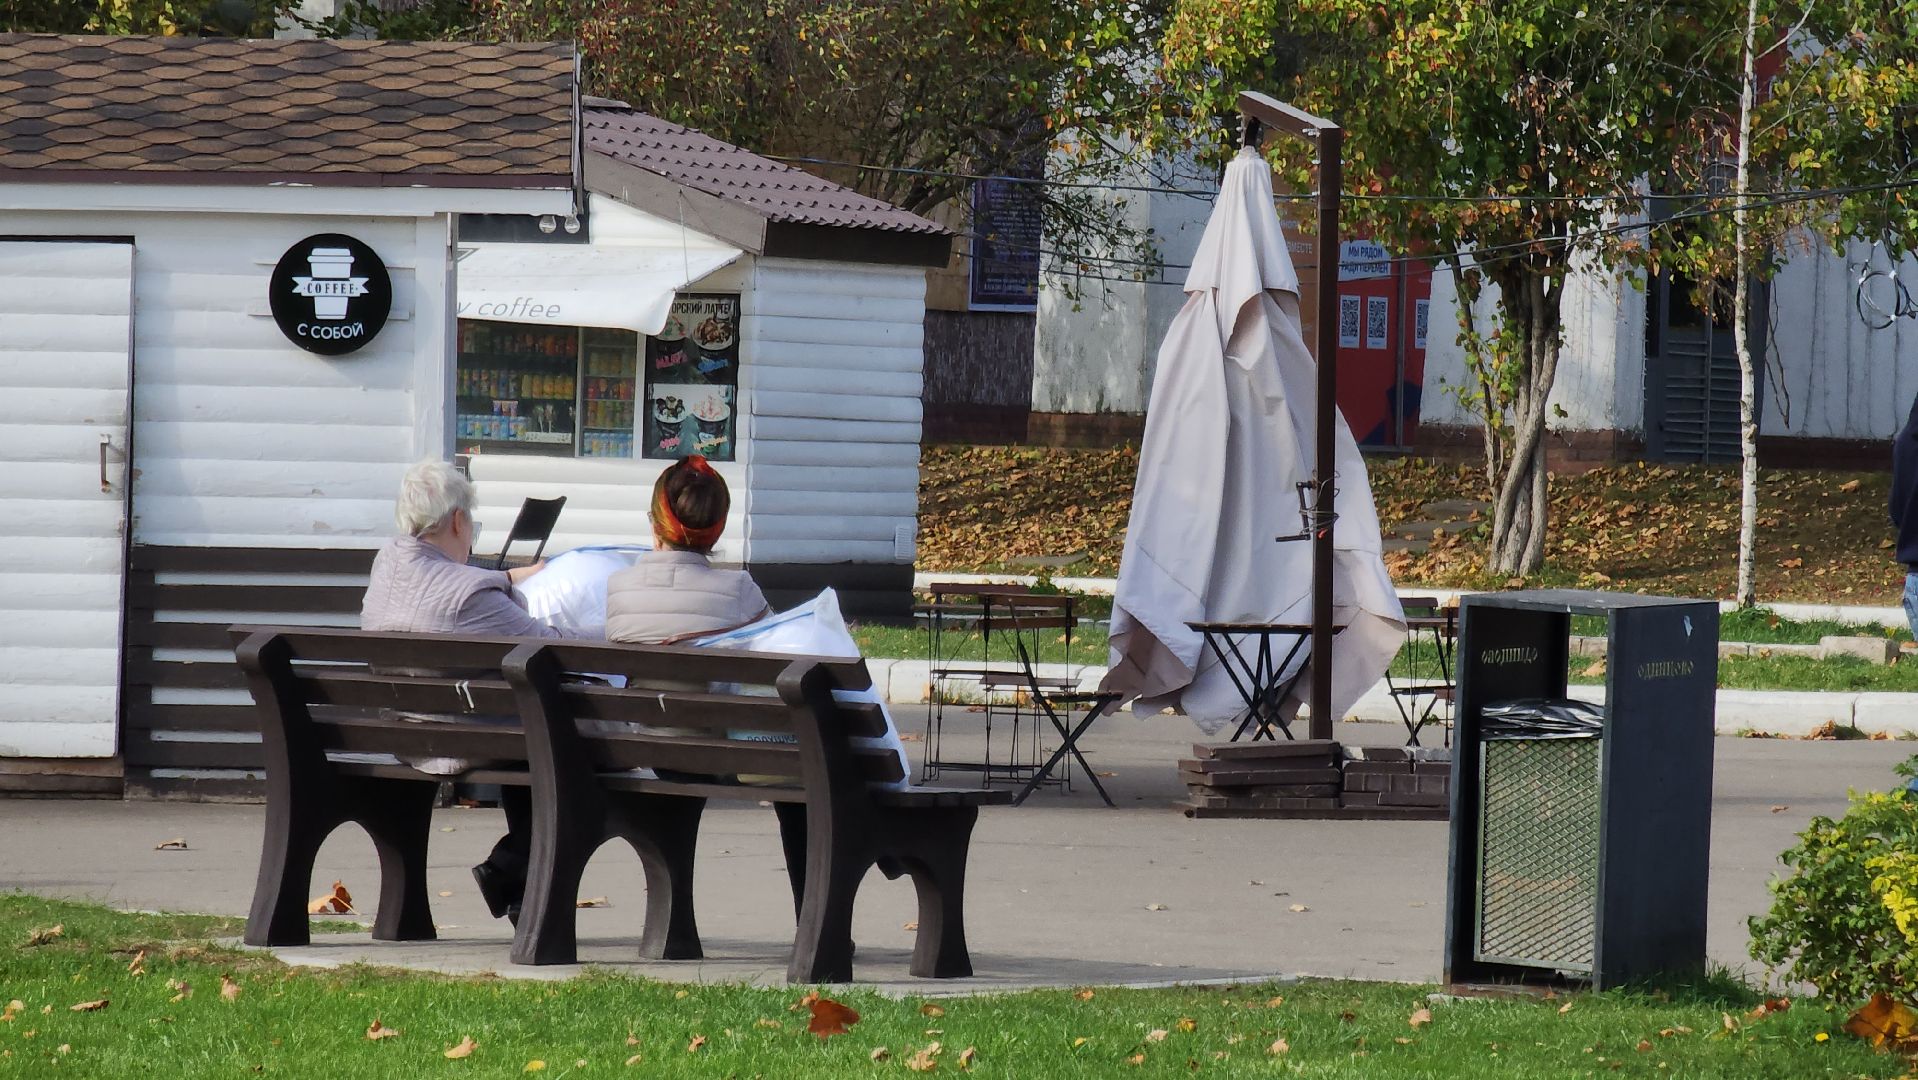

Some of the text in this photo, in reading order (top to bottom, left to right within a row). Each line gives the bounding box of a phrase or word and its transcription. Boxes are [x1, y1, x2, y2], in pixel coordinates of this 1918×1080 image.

[1348, 246, 1383, 260] МЫ РЯДОМ
[307, 283, 355, 294] COFFEE
[478, 297, 561, 318] coffee
[671, 301, 730, 315] ОРСКИЙ ЛАТТЕ
[297, 322, 364, 339] С СОБОЙ
